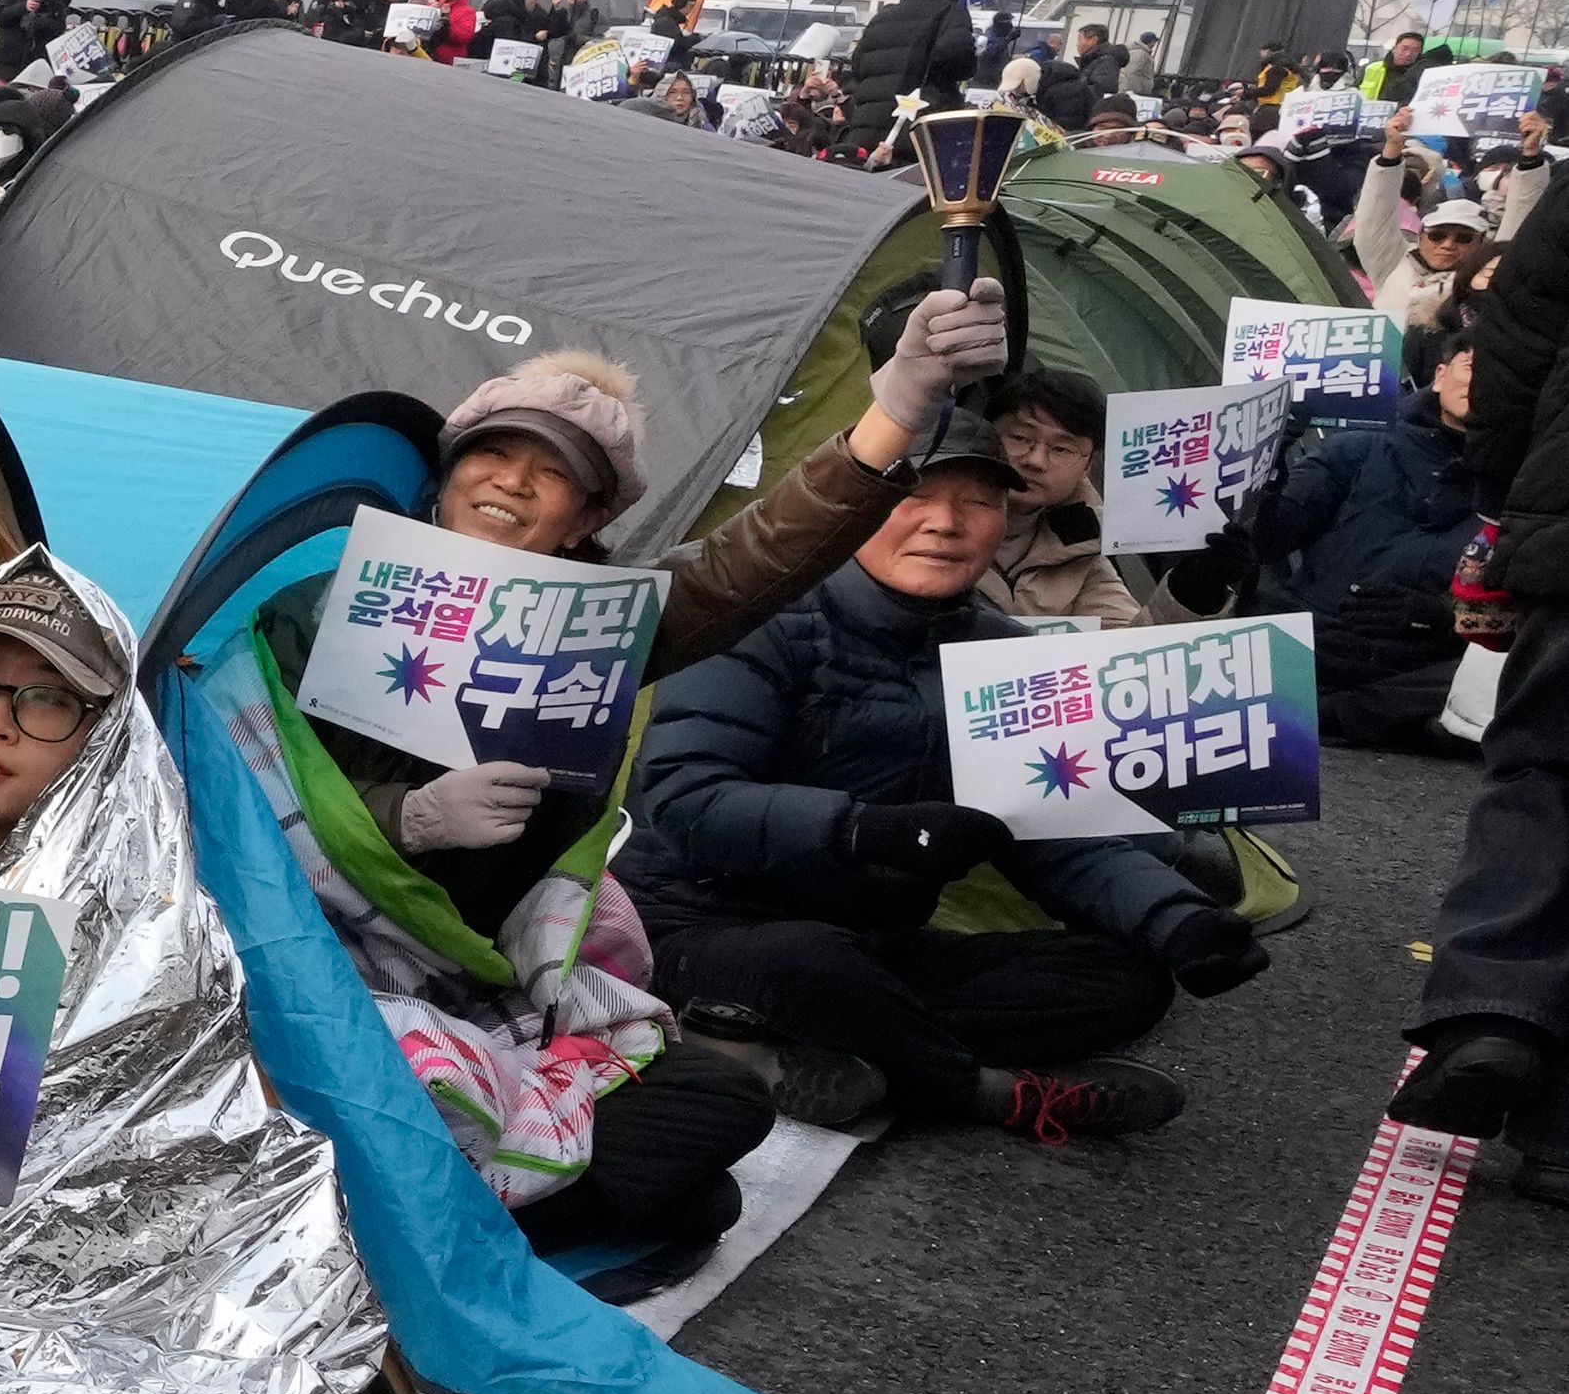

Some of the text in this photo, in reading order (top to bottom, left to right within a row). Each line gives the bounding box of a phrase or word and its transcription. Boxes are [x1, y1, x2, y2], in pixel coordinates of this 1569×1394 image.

[1463, 70, 1535, 95] 체포!
[1457, 94, 1528, 121] 구속!
[1093, 168, 1164, 186] TICLA
[219, 230, 533, 346] Quechua
[1232, 338, 1281, 364] 윤석열
[1234, 320, 1285, 343] 내란수괴
[1282, 316, 1385, 361] 체포!
[1286, 357, 1382, 402] 구속!
[1121, 410, 1213, 451] 내란수괴
[1120, 436, 1210, 479] 윤석열
[359, 558, 489, 605] 내란수괴
[348, 588, 475, 644] 윤석열
[479, 580, 650, 657] 체포!
[459, 658, 627, 731] 구속!
[964, 663, 1094, 716] 내란동조
[1104, 626, 1275, 723] 해체
[968, 693, 1094, 743] 국민의힘
[1107, 701, 1278, 791] 하라
[1373, 1208, 1416, 1240] DANGER
[1337, 1305, 1382, 1328] 위험
[1322, 1329, 1372, 1369] DANGER
